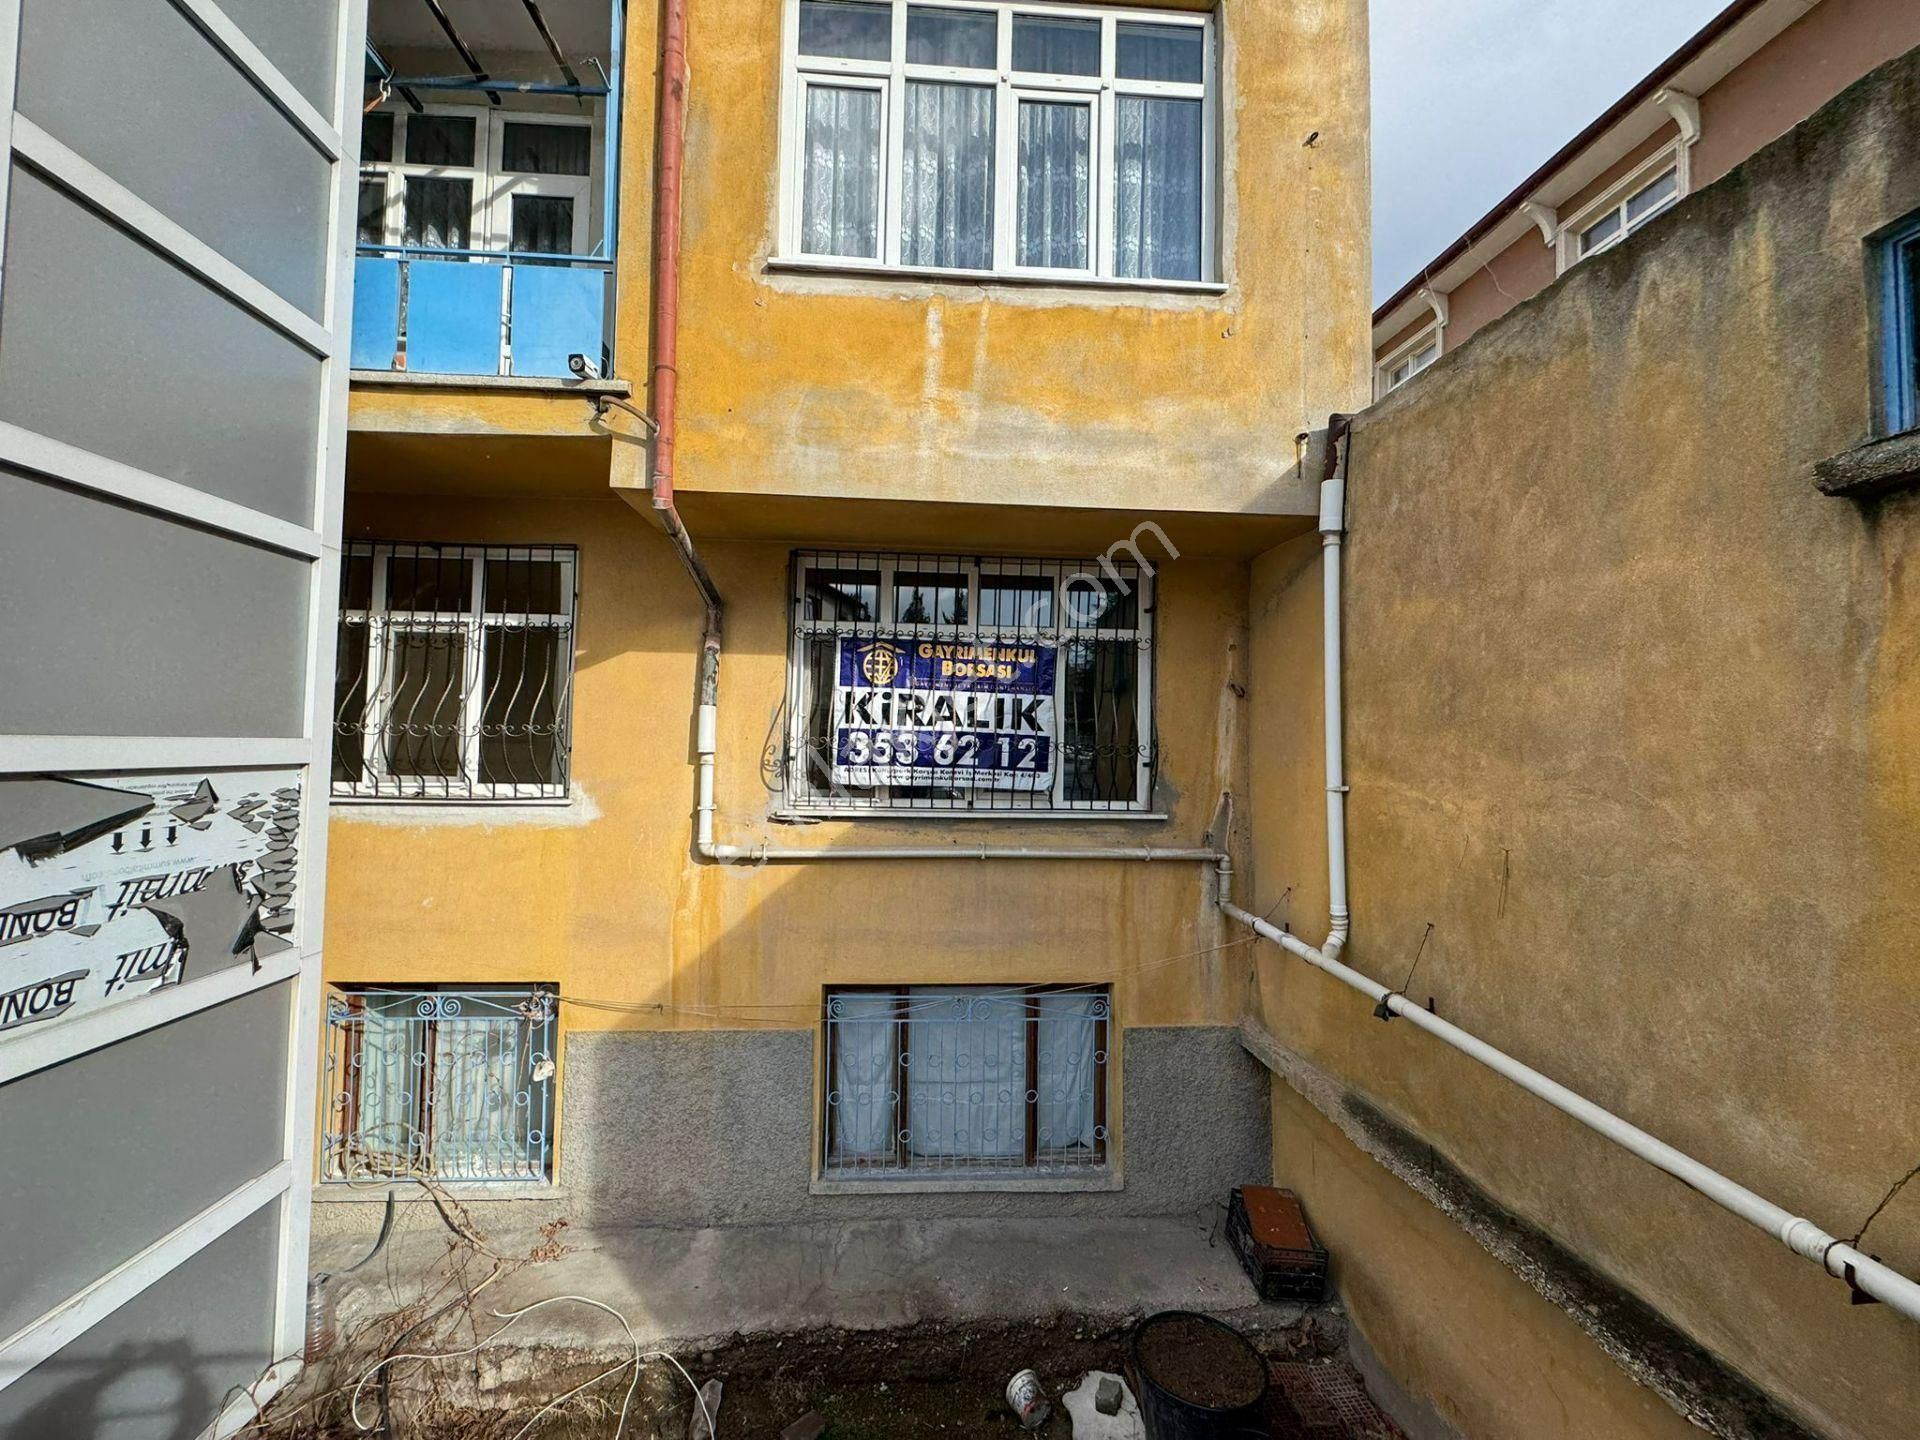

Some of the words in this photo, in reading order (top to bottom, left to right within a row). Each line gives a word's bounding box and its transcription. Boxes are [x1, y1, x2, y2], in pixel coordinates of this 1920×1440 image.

[848, 731, 919, 766] 353
[933, 733, 981, 767] 62
[996, 736, 1037, 770] 12
[0, 898, 78, 942] BON
[0, 978, 77, 1025] BON
